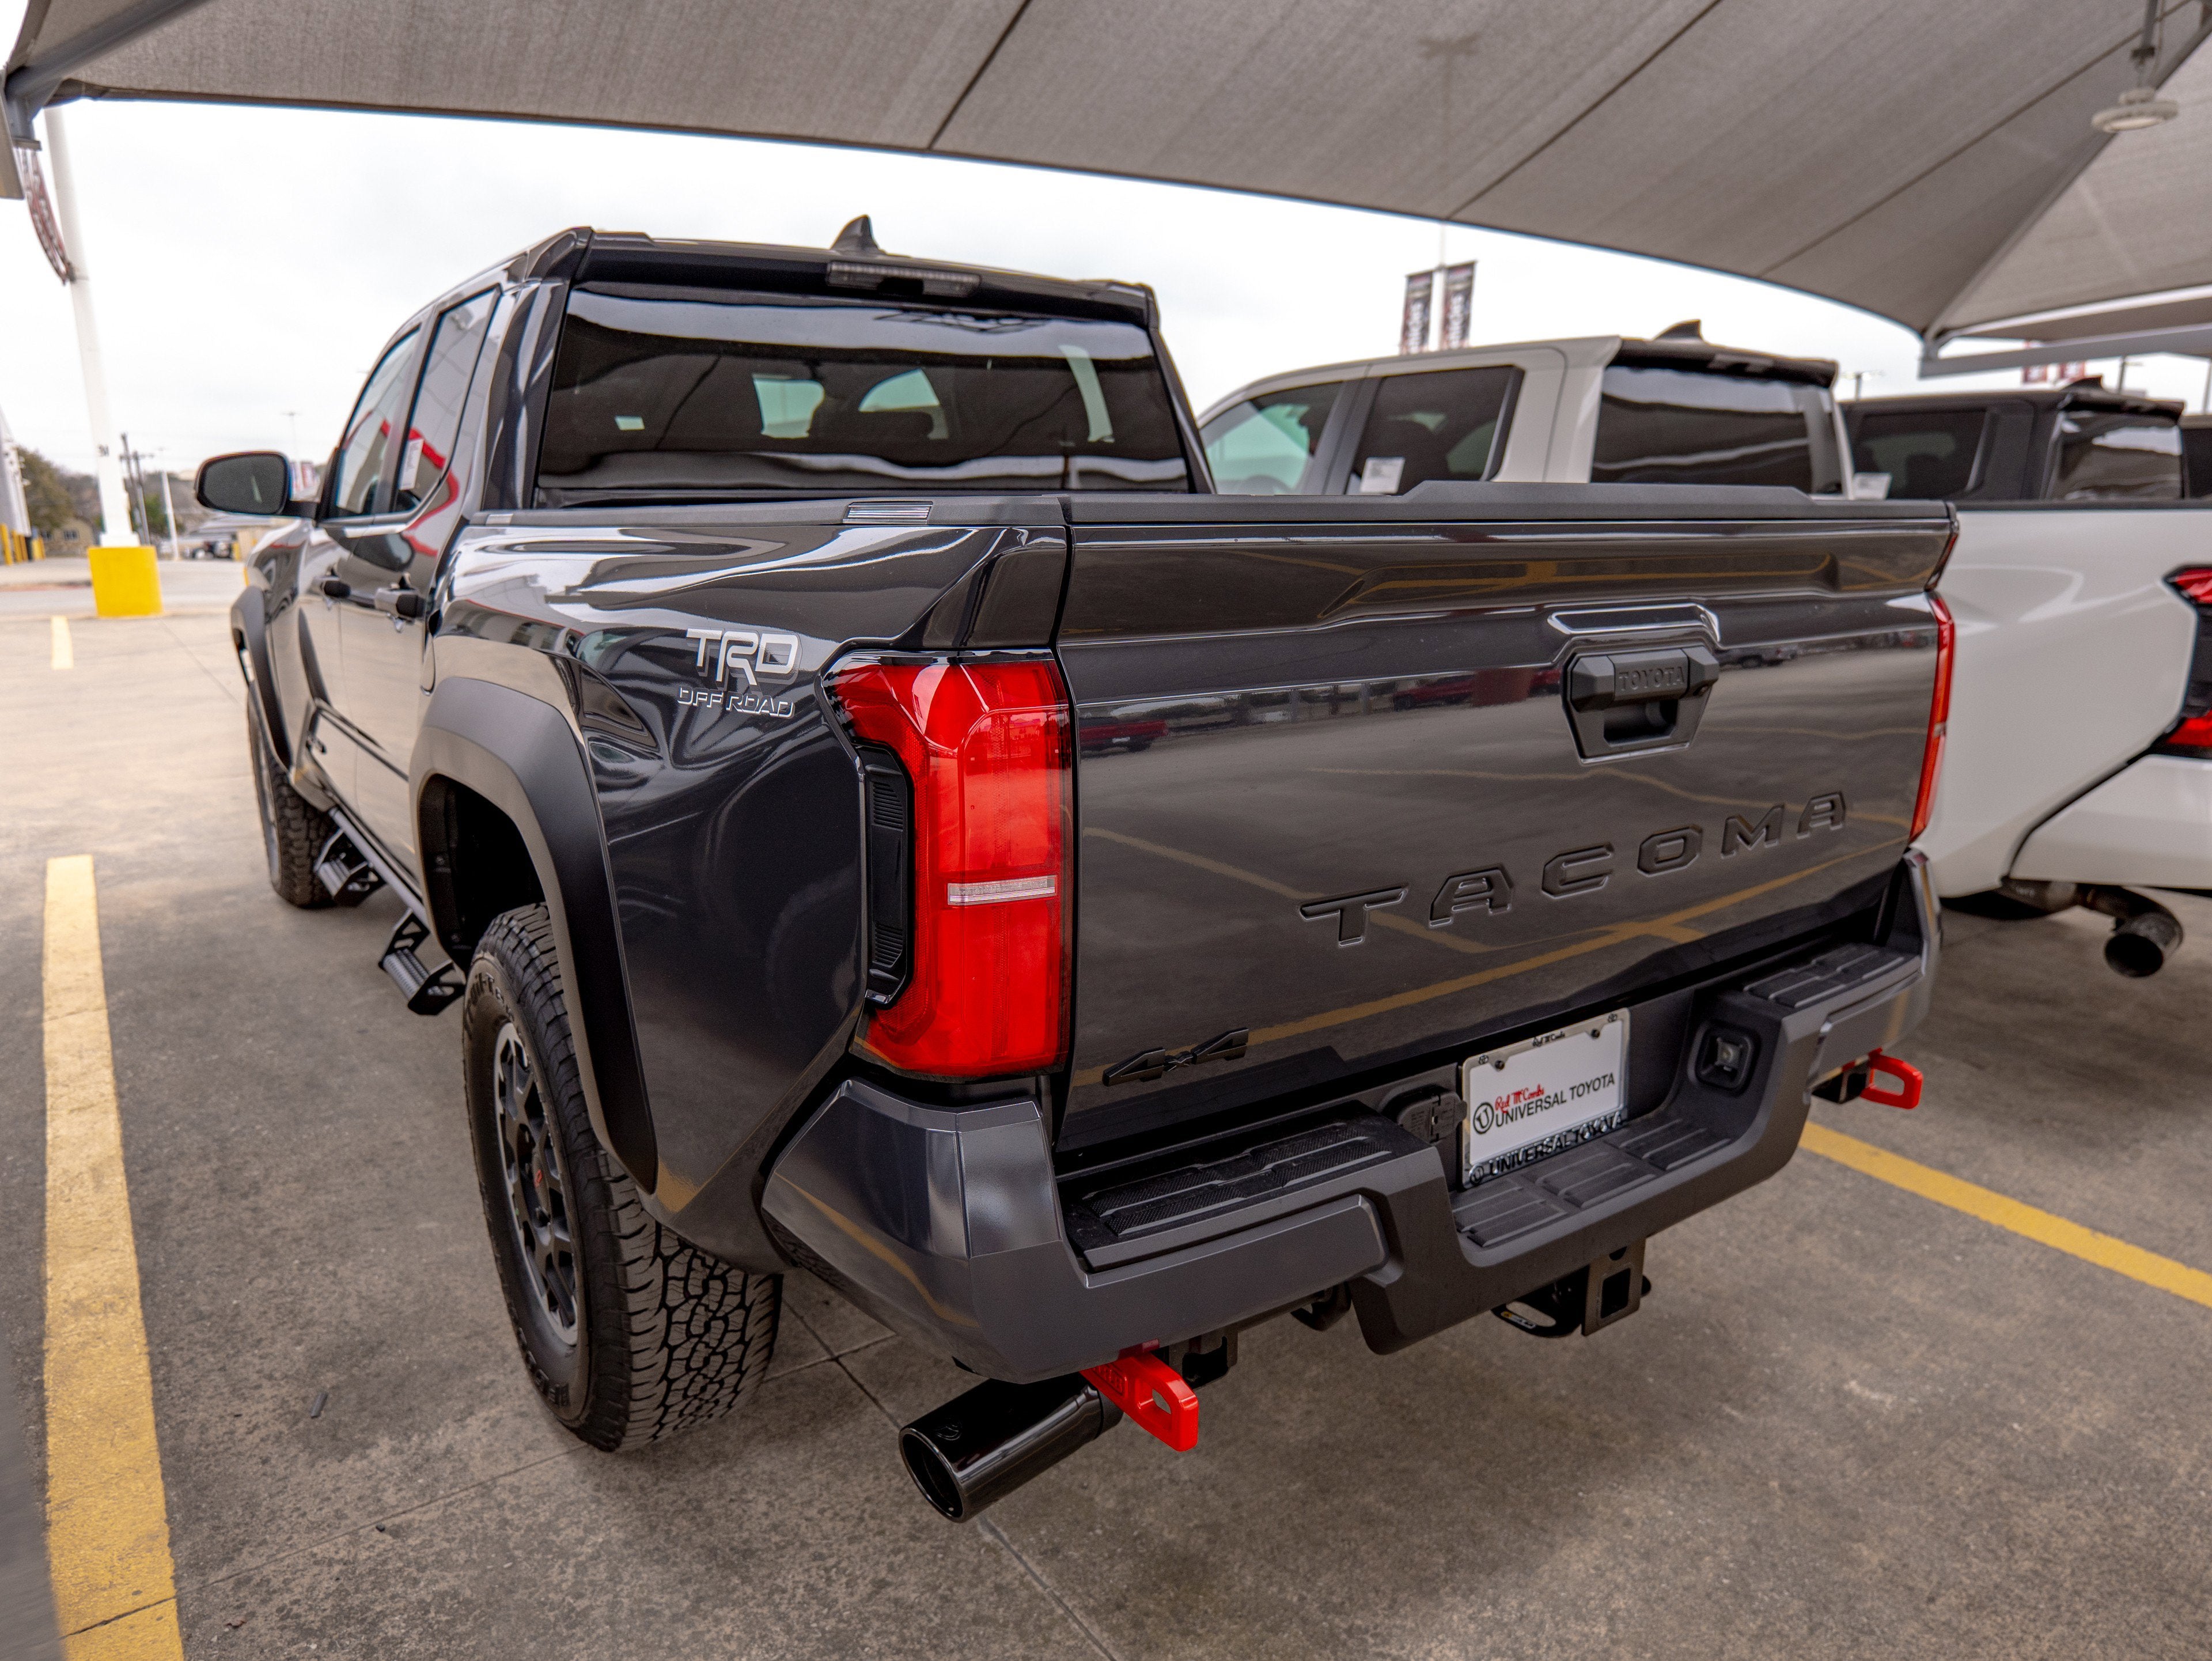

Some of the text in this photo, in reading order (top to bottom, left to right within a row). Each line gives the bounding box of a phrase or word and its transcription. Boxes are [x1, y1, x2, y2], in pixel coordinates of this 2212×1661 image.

[686, 629, 798, 686] TRD
[1618, 666, 1685, 691] TOYOTA
[677, 686, 795, 718] OFF ROAD
[1298, 791, 1846, 947] TACOMA
[1495, 1094, 1510, 1113] Red
[1496, 1073, 1615, 1127] UNIVERSAL TOYOTA
[1489, 1111, 1623, 1175] UNIVERSAL TOYOTA
